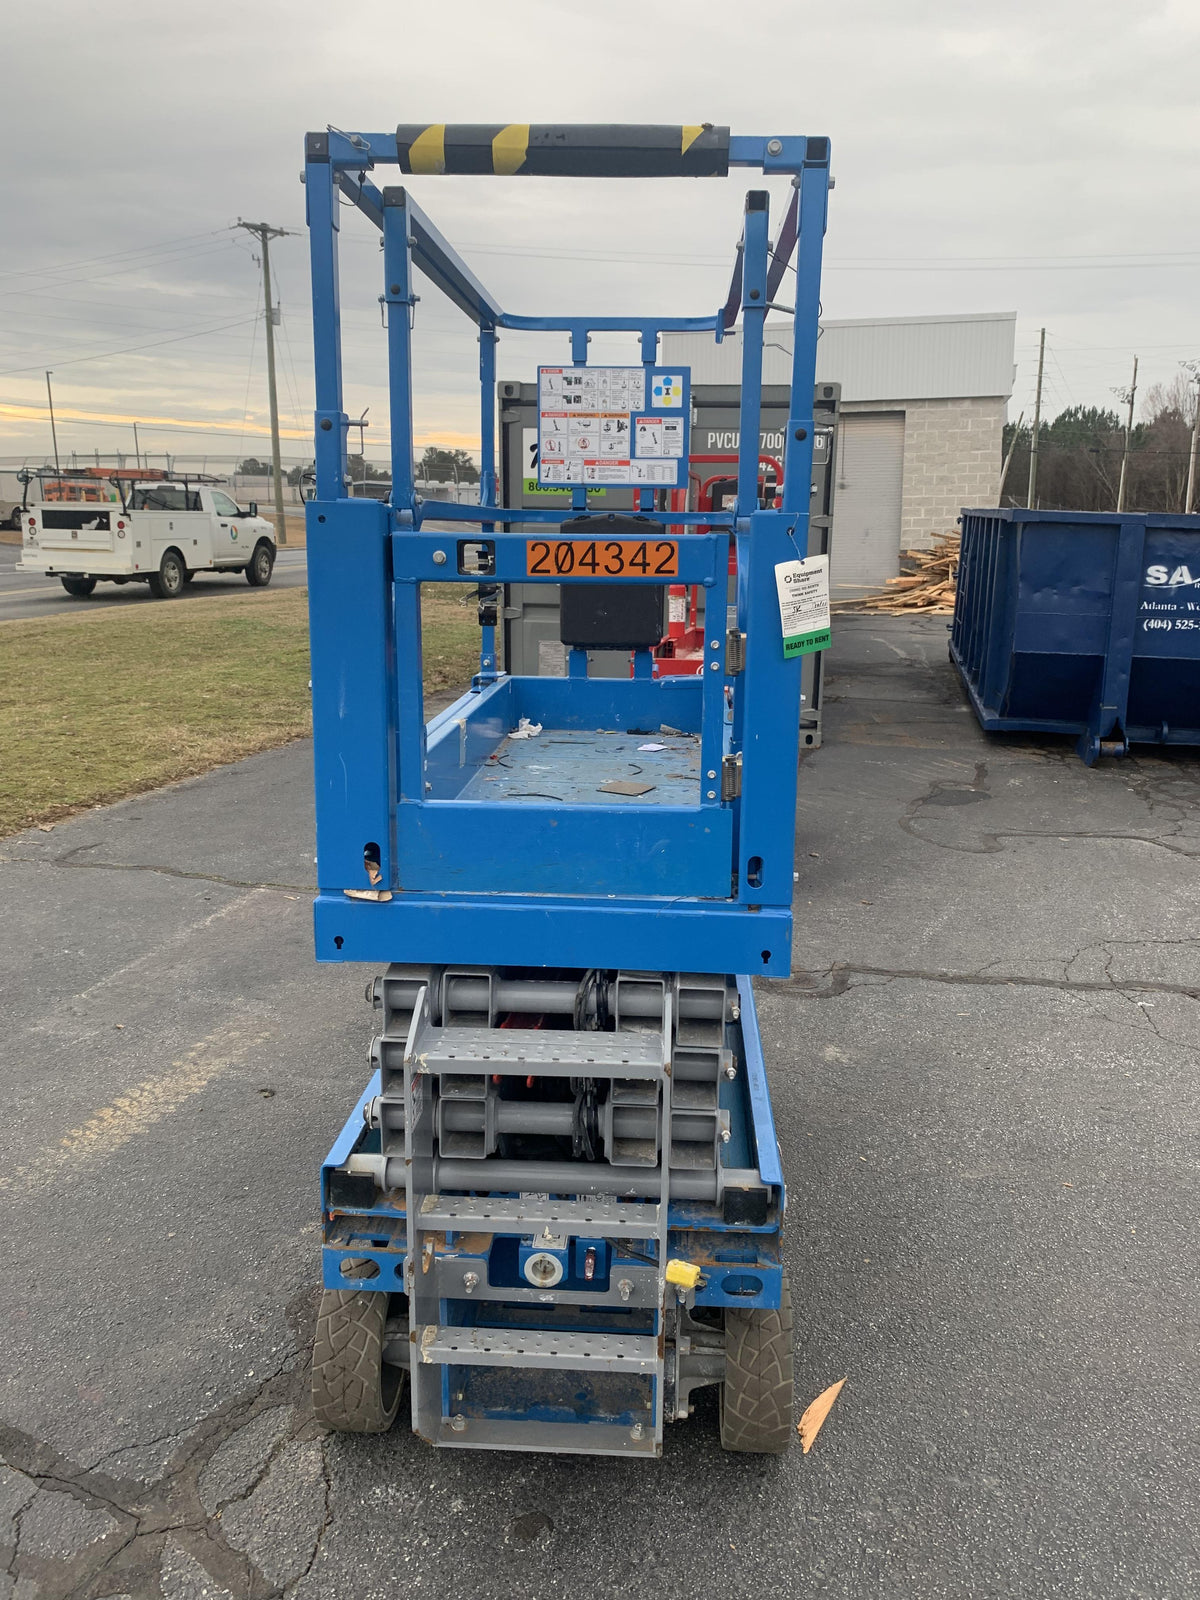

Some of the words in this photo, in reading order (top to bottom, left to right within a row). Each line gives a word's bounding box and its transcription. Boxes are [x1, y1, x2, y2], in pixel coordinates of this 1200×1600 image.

[707, 432, 740, 449] PVCU
[530, 541, 675, 575] 204342
[792, 568, 823, 578] Equipment
[1140, 601, 1177, 610] Atlanta
[1143, 619, 1172, 632] (404)
[1175, 619, 1200, 630] 525-
[785, 640, 805, 651] READY
[806, 638, 814, 646] TO
[814, 634, 829, 644] RENT
